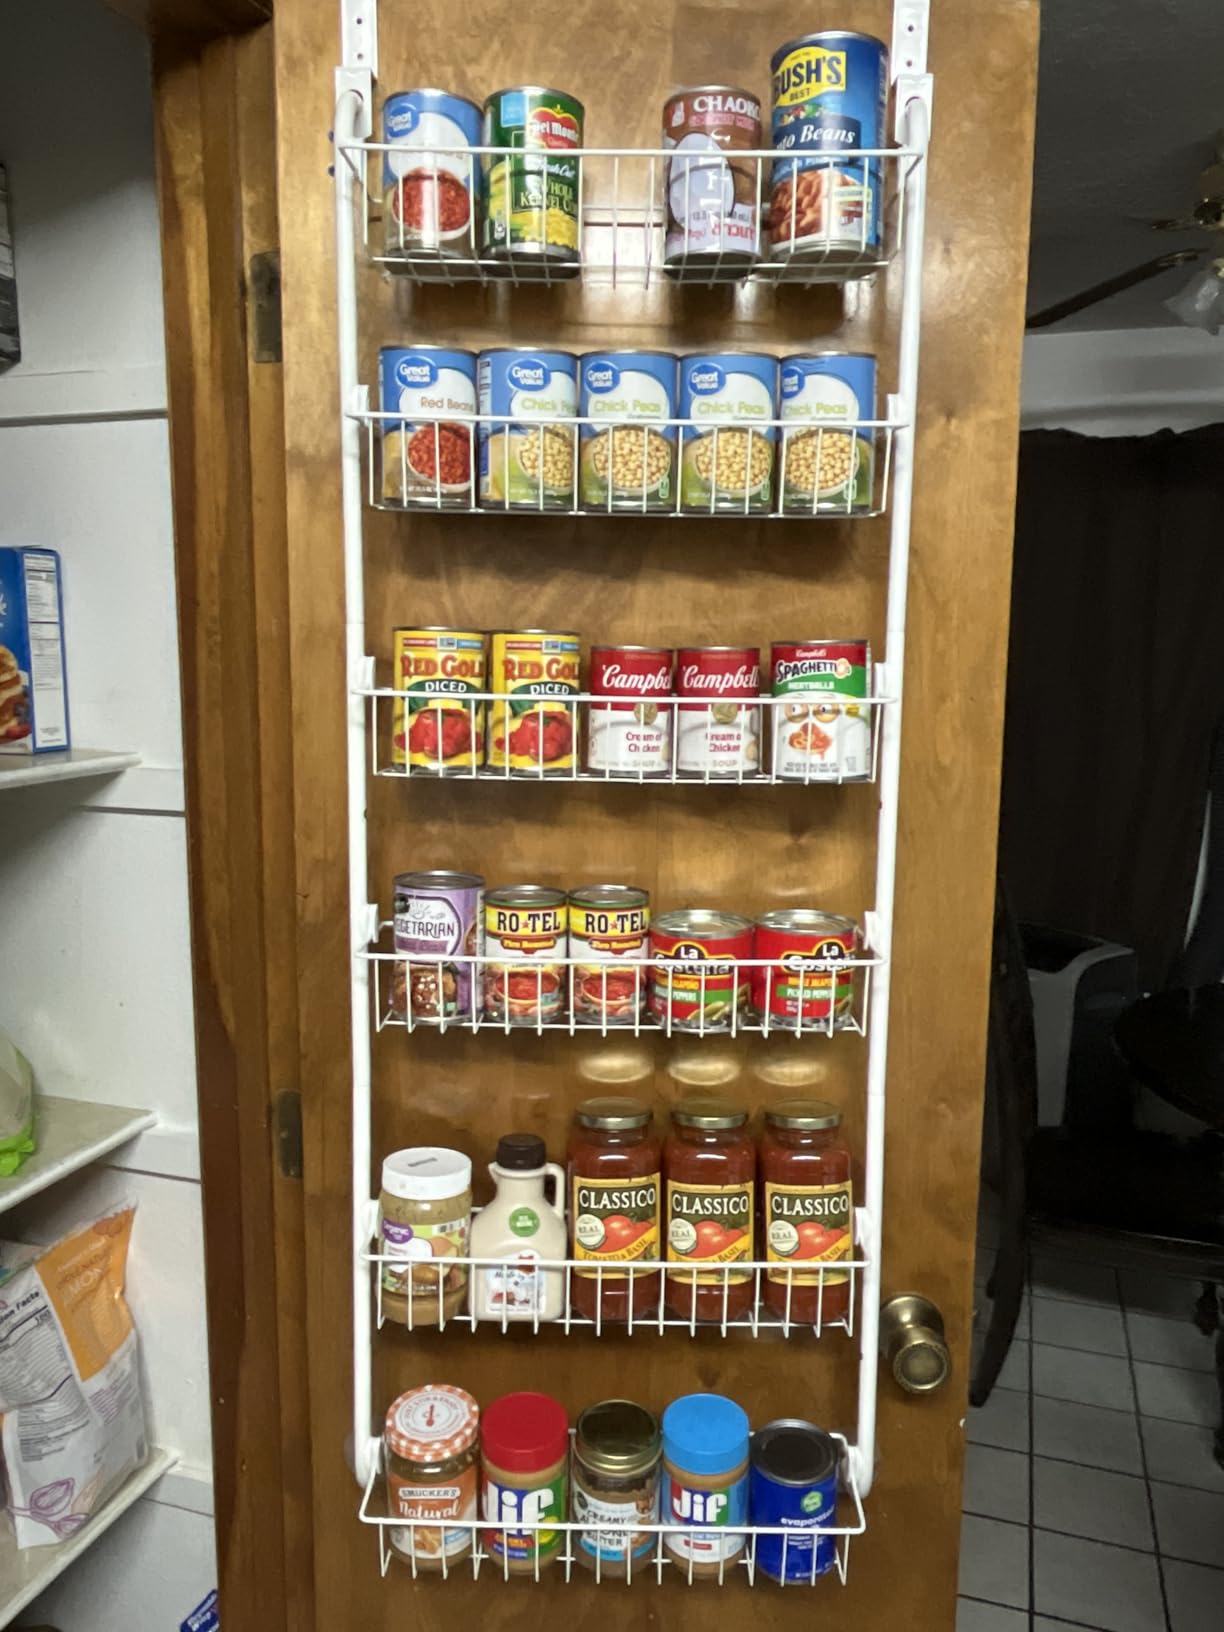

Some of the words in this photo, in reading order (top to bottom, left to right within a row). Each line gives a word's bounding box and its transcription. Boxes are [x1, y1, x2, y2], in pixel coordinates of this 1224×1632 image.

[800, 124, 855, 144] Beans
[400, 364, 431, 376] Great
[512, 366, 544, 379] Great
[588, 369, 613, 381] Great
[692, 371, 718, 383] Great
[421, 397, 444, 409] Red
[521, 397, 557, 411] Chick
[594, 400, 628, 412] Chick
[632, 399, 661, 413] Peas
[698, 401, 733, 414] Chick
[738, 401, 766, 415] Peas
[815, 402, 847, 414] Peas
[400, 654, 439, 679] RED
[502, 657, 544, 682] RED
[683, 664, 758, 694] Campbell
[425, 680, 467, 693] DICED
[530, 683, 570, 695] DICED
[681, 946, 698, 959] La
[822, 943, 839, 957] La
[579, 1187, 656, 1210] CLASSICO
[672, 1193, 749, 1215] CLASSICO
[771, 1194, 849, 1216] CLASSICO
[399, 1499, 460, 1519] Natural
[672, 1488, 728, 1523] Jif
[586, 1509, 627, 1525] CREAMY
